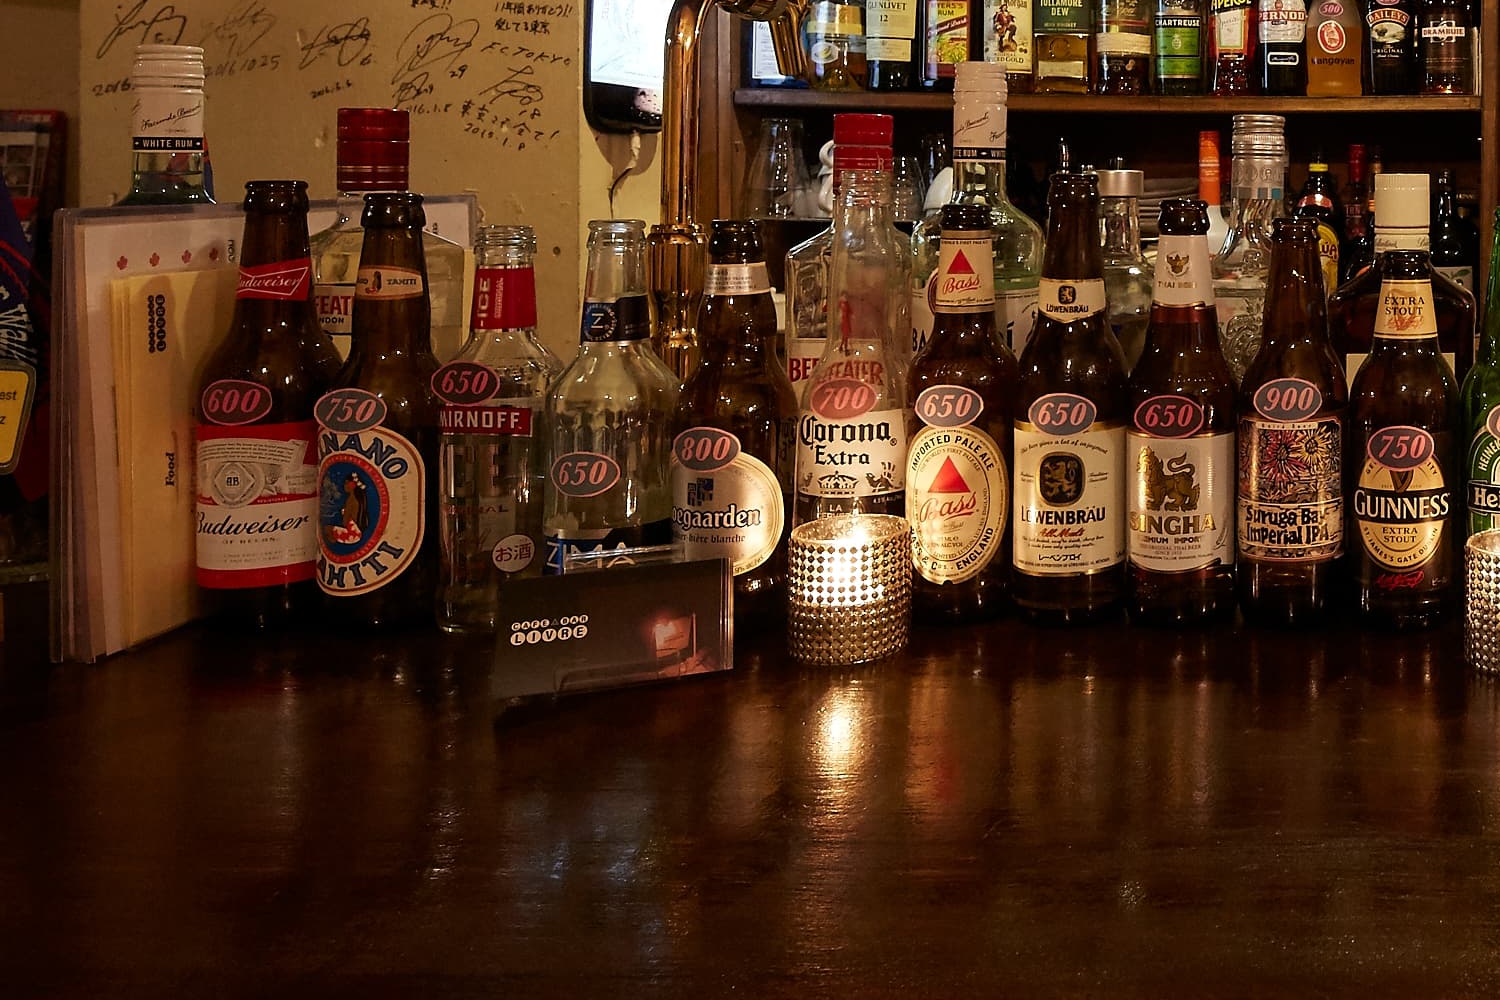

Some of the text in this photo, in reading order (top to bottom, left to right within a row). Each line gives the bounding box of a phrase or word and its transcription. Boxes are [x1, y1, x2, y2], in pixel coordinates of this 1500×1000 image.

[868, 1, 907, 11] GLENLIVET
[1051, 8, 1069, 16] DEW
[1259, 10, 1306, 21] PERNOD
[1322, 5, 1341, 14] 500
[1367, 8, 1409, 26] BAILEYS
[1155, 19, 1200, 27] CHARTREUSE
[1423, 28, 1465, 36] DRAMBUIE
[143, 139, 193, 148] WHITE RUM
[238, 273, 302, 291] udweiser
[387, 278, 417, 286] TAHITI
[943, 274, 981, 294] Bass
[1384, 296, 1426, 306] EXTRA
[1385, 306, 1424, 316] STOUT
[440, 370, 489, 395] 650
[207, 388, 261, 413] 600
[819, 386, 868, 411] 700
[923, 393, 972, 418] 650
[1263, 387, 1314, 411] 900
[325, 398, 377, 423] 750
[1037, 402, 1087, 426] 650
[1145, 404, 1194, 427] 650
[800, 414, 892, 451] Corona
[318, 433, 408, 480] NANO
[682, 436, 731, 461] 800
[814, 444, 870, 466] Extra
[912, 434, 995, 472] IMPORTED PALE ALE
[1378, 434, 1426, 459] 750
[164, 452, 176, 487] Food
[558, 460, 608, 486] 650
[829, 504, 843, 512] LA
[919, 491, 977, 523] Bass
[1354, 489, 1450, 520] GUINNESS
[1129, 511, 1217, 535] SINGHA
[1246, 505, 1298, 529] Suruga
[1247, 523, 1329, 545] Imperial IPA
[1382, 526, 1419, 535] EXTRA
[1383, 535, 1417, 544] STOUT
[494, 543, 532, 562] お酒
[956, 527, 994, 571] ENGLAND
[1396, 553, 1418, 564] GATE
[511, 614, 589, 632] CAFE BAR
[510, 624, 589, 646] LIVRE
